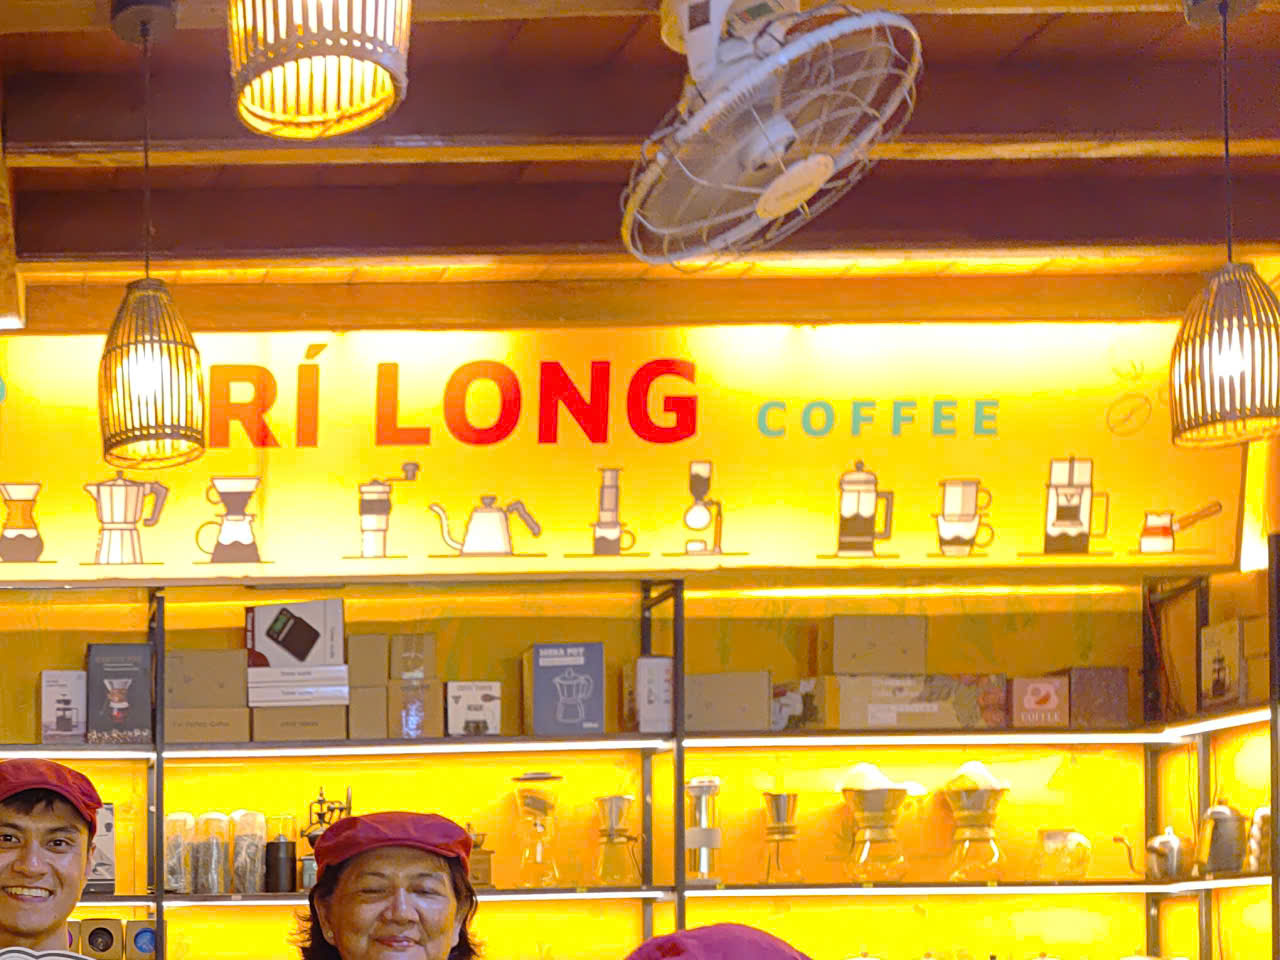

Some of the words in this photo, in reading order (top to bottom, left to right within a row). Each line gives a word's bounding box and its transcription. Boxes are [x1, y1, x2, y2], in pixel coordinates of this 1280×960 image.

[208, 343, 328, 448] RÍ
[374, 357, 698, 446] LONG
[756, 399, 1001, 438] COFFEE
